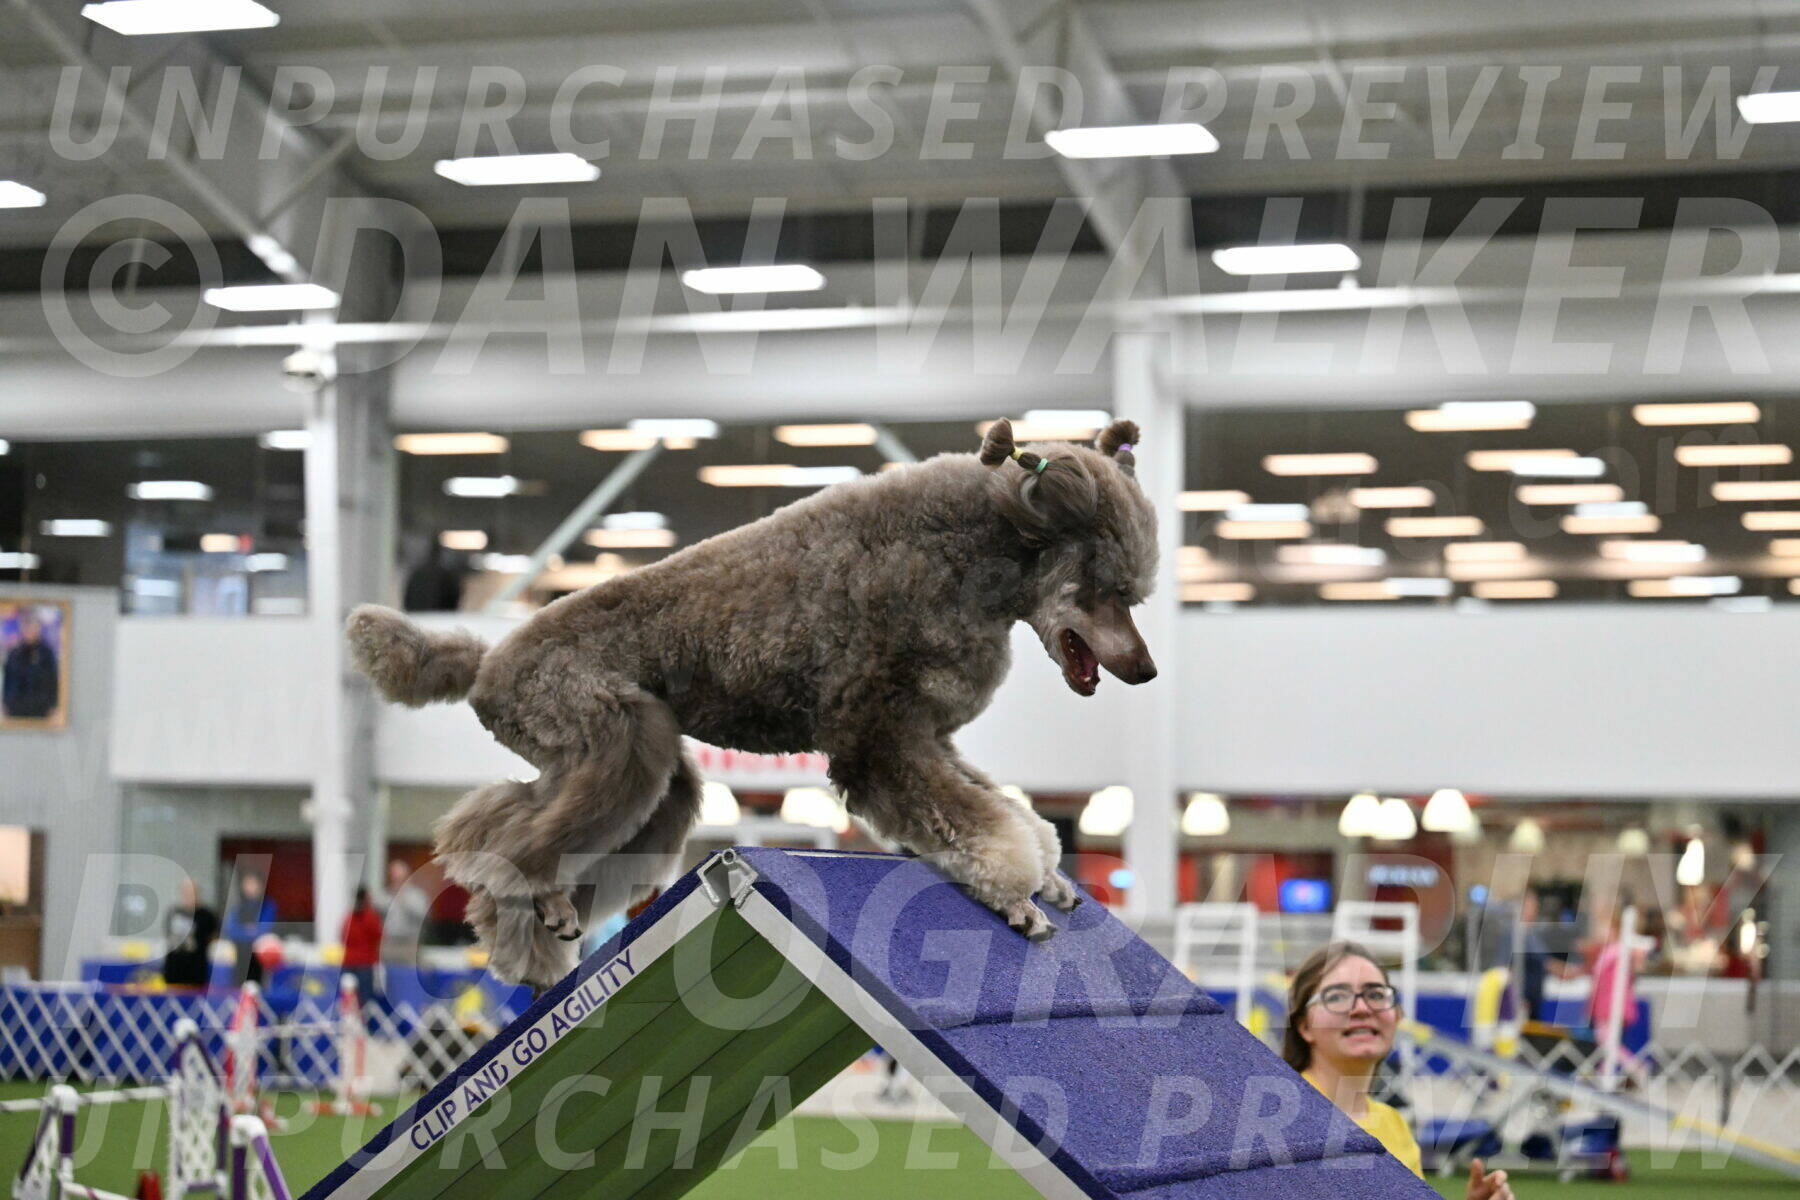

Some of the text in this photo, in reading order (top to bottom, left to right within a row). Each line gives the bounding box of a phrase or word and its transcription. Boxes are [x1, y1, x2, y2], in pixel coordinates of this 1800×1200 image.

[410, 949, 636, 1150] CLIP AND GO AGILITY
